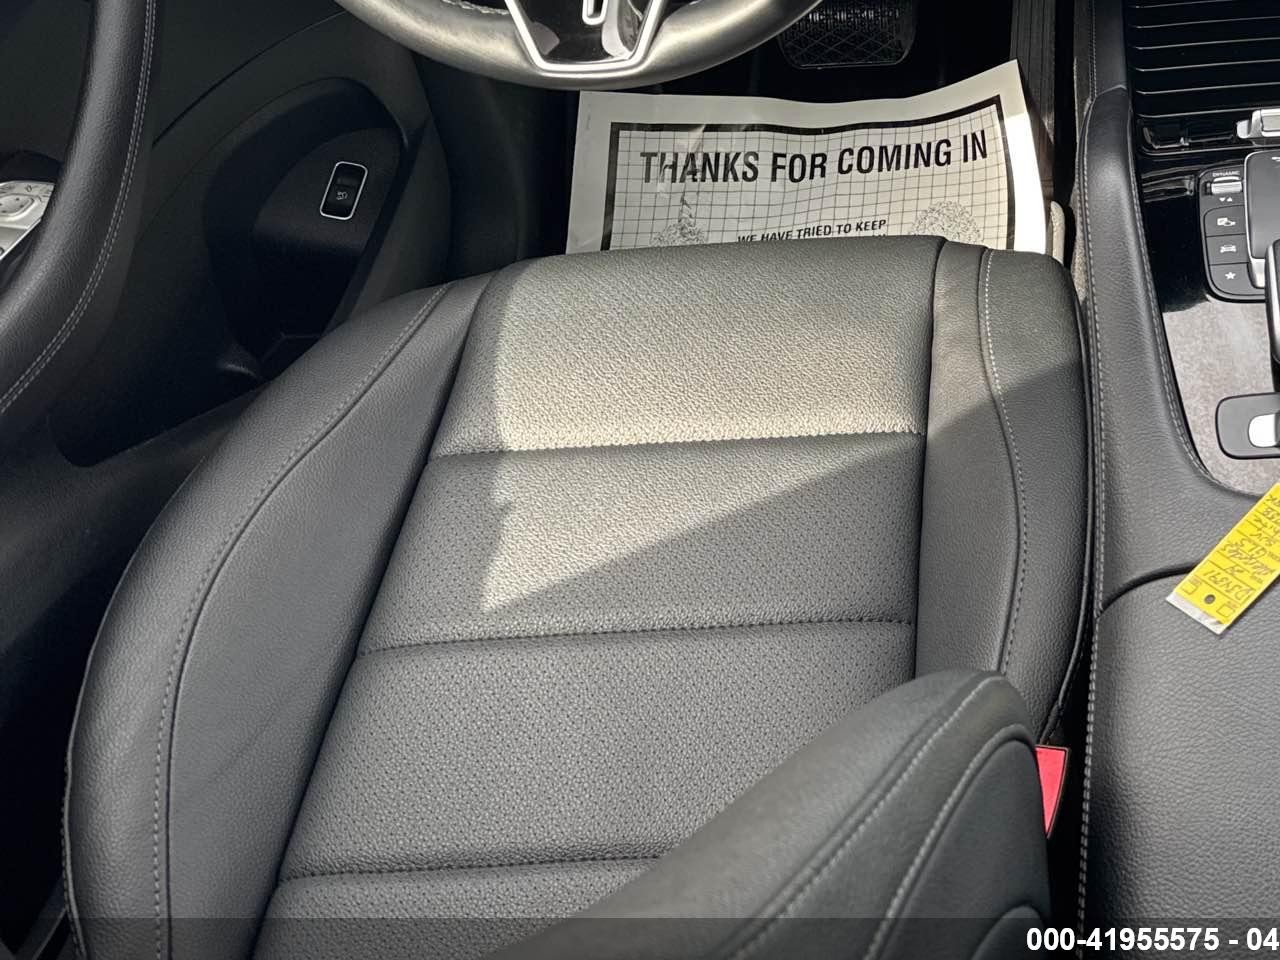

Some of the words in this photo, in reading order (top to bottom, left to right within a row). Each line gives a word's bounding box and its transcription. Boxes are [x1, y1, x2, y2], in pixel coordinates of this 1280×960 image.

[640, 151, 758, 184] THANKS
[770, 152, 827, 183] FOR
[837, 138, 952, 176] COMING
[962, 130, 988, 162] IN
[760, 230, 792, 241] HAVE
[797, 224, 832, 239] TRIED
[835, 223, 852, 235] TO
[856, 219, 886, 232] KEEP
